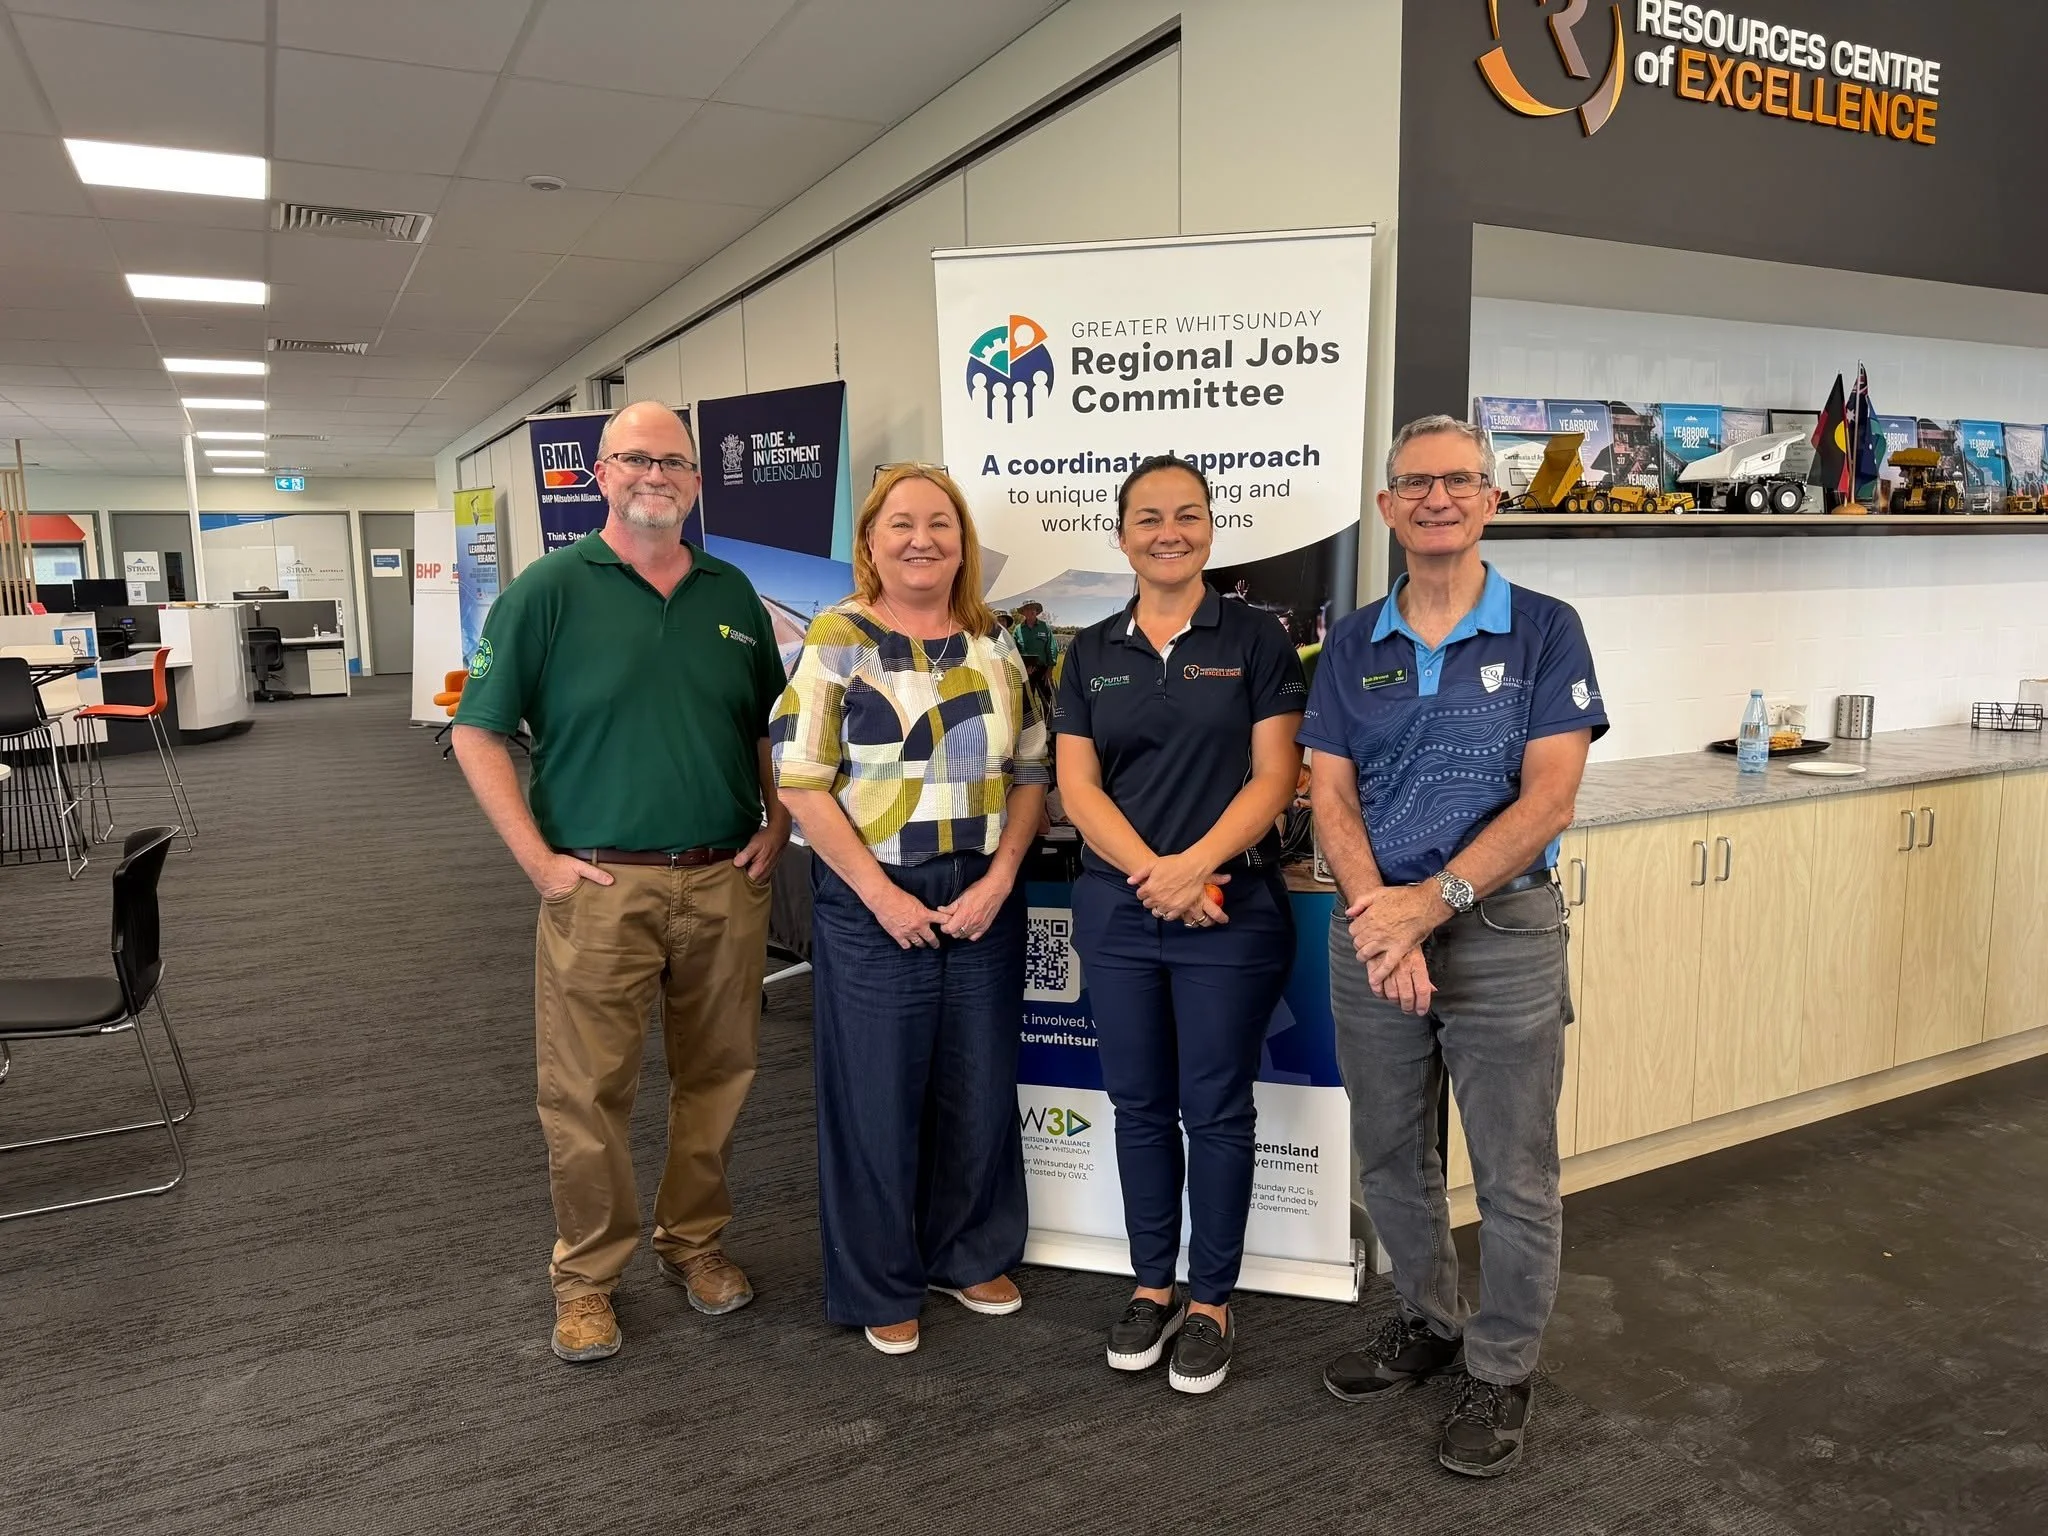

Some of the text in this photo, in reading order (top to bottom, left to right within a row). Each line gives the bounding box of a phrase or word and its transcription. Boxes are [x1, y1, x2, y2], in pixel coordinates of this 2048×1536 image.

[1637, 0, 1941, 95] RESOURCES CENTRE
[1635, 46, 1938, 145] of EXCELLENCE
[1071, 310, 1322, 338] GREATER WHITSUNDAY
[1072, 335, 1340, 381] Regional Jobs
[1072, 378, 1285, 414] Committee
[1559, 419, 1599, 432] YEARBOOK
[1673, 426, 1709, 438] YEARBOOK
[751, 431, 784, 449] TRADE
[1682, 438, 1699, 448] 2022
[1884, 432, 1908, 445] EARBOOK
[1969, 438, 1995, 449] YEARBOOK
[540, 443, 584, 470] BMA
[753, 445, 821, 466] INVESTMENT
[1976, 448, 1989, 458] 2022
[981, 455, 1000, 476] A
[1007, 450, 1175, 475] coordinat
[752, 462, 822, 485] QUEENSLAND
[1628, 474, 1659, 486] YEARBOOK
[1007, 487, 1029, 504] to
[1036, 484, 1107, 507] unique
[1249, 481, 1291, 498] and
[1042, 514, 1121, 532] workfor
[547, 532, 567, 541] Think
[287, 566, 313, 574] STRATA
[416, 563, 441, 579] BHP
[1031, 1013, 1089, 1030] involved,
[1020, 1106, 1065, 1136] W3
[1052, 1146, 1091, 1155] WHITSUNDAY
[1060, 1139, 1091, 1148] ALLIANCE
[1254, 1142, 1319, 1159] eensland
[1033, 1158, 1077, 1170] Whitsunday
[1078, 1163, 1094, 1171] RJC
[1254, 1158, 1319, 1174] vernment
[1030, 1168, 1056, 1177] hosted
[1058, 1171, 1067, 1179] by
[1254, 1182, 1314, 1196] tsunday RJC is
[1257, 1202, 1310, 1215] Government.
[1277, 1195, 1307, 1205] funded
[1308, 1198, 1319, 1207] by
